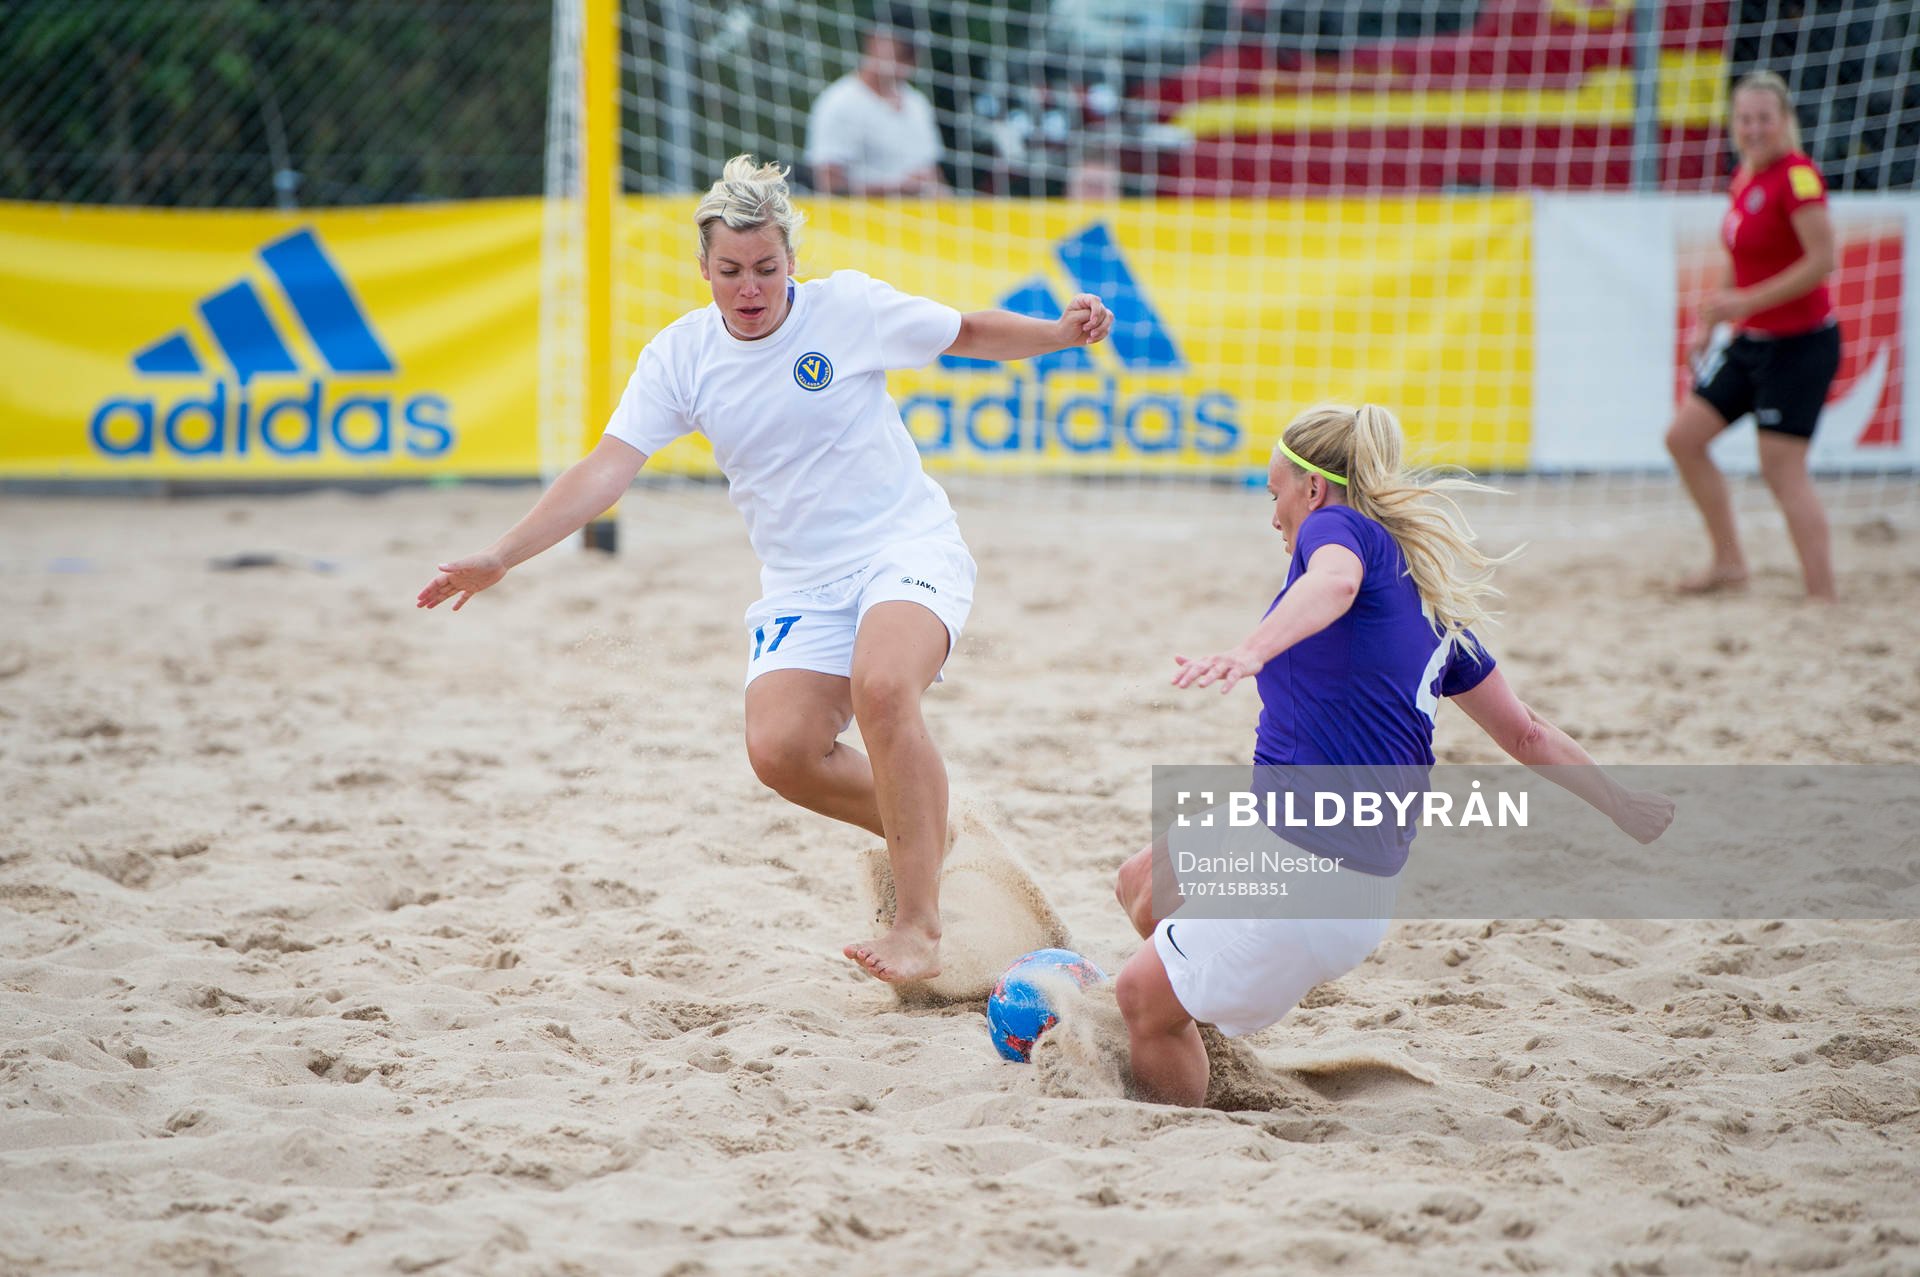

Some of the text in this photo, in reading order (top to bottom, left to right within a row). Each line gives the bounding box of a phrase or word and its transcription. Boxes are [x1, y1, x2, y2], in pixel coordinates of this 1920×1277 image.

[90, 378, 456, 458] adidas
[900, 375, 1241, 456] adidas
[915, 579, 937, 594] JAKO
[753, 615, 802, 661] 17
